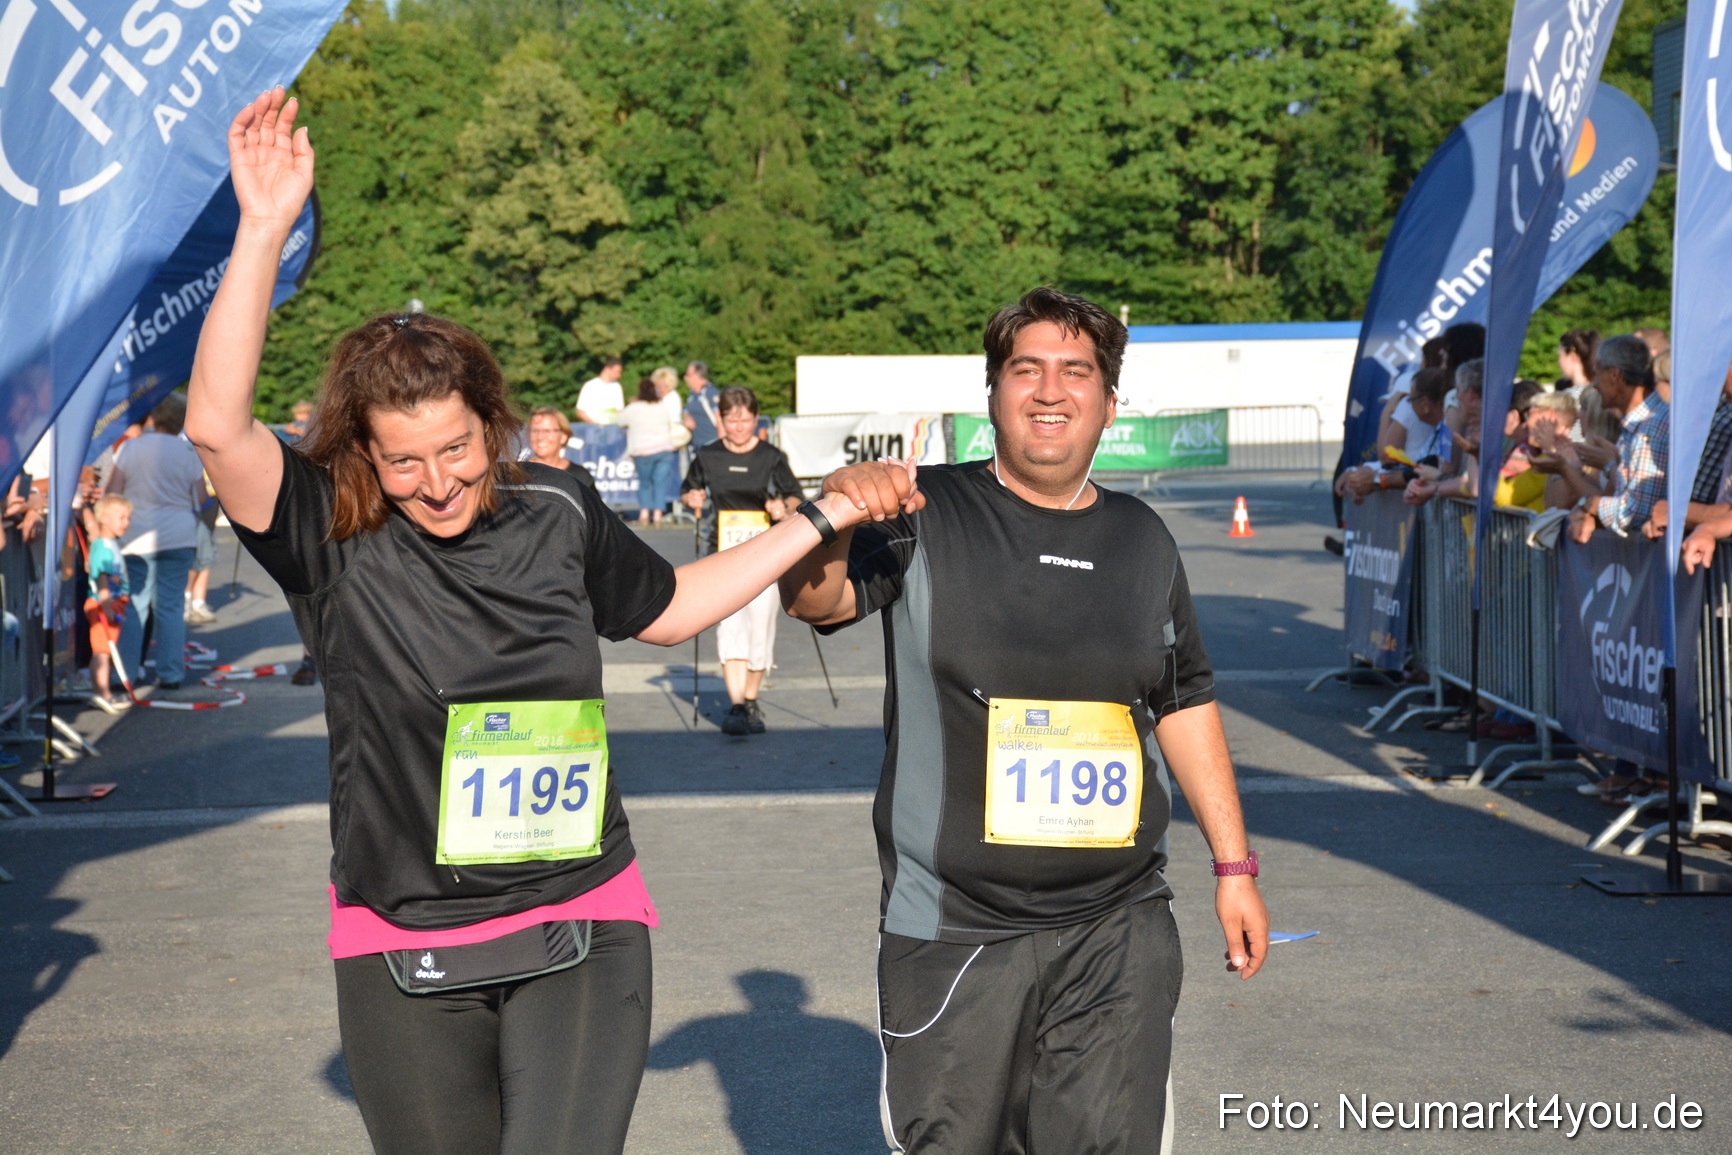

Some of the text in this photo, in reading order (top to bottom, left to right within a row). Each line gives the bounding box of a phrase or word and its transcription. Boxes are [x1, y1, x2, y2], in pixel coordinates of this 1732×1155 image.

[1575, 156, 1638, 213] Medien
[1169, 420, 1222, 449] AOK
[1592, 621, 1664, 694] Fischer
[472, 729, 534, 741] firmenlauf
[533, 736, 564, 747] 2016
[1014, 724, 1071, 736] firmenlauf
[997, 739, 1043, 751] walken
[462, 763, 590, 818] 1195
[1006, 758, 1127, 806] 1198
[1039, 815, 1094, 828] Emre Ayhan
[494, 828, 554, 840] Kerstin Beer
[415, 969, 446, 979] deuter
